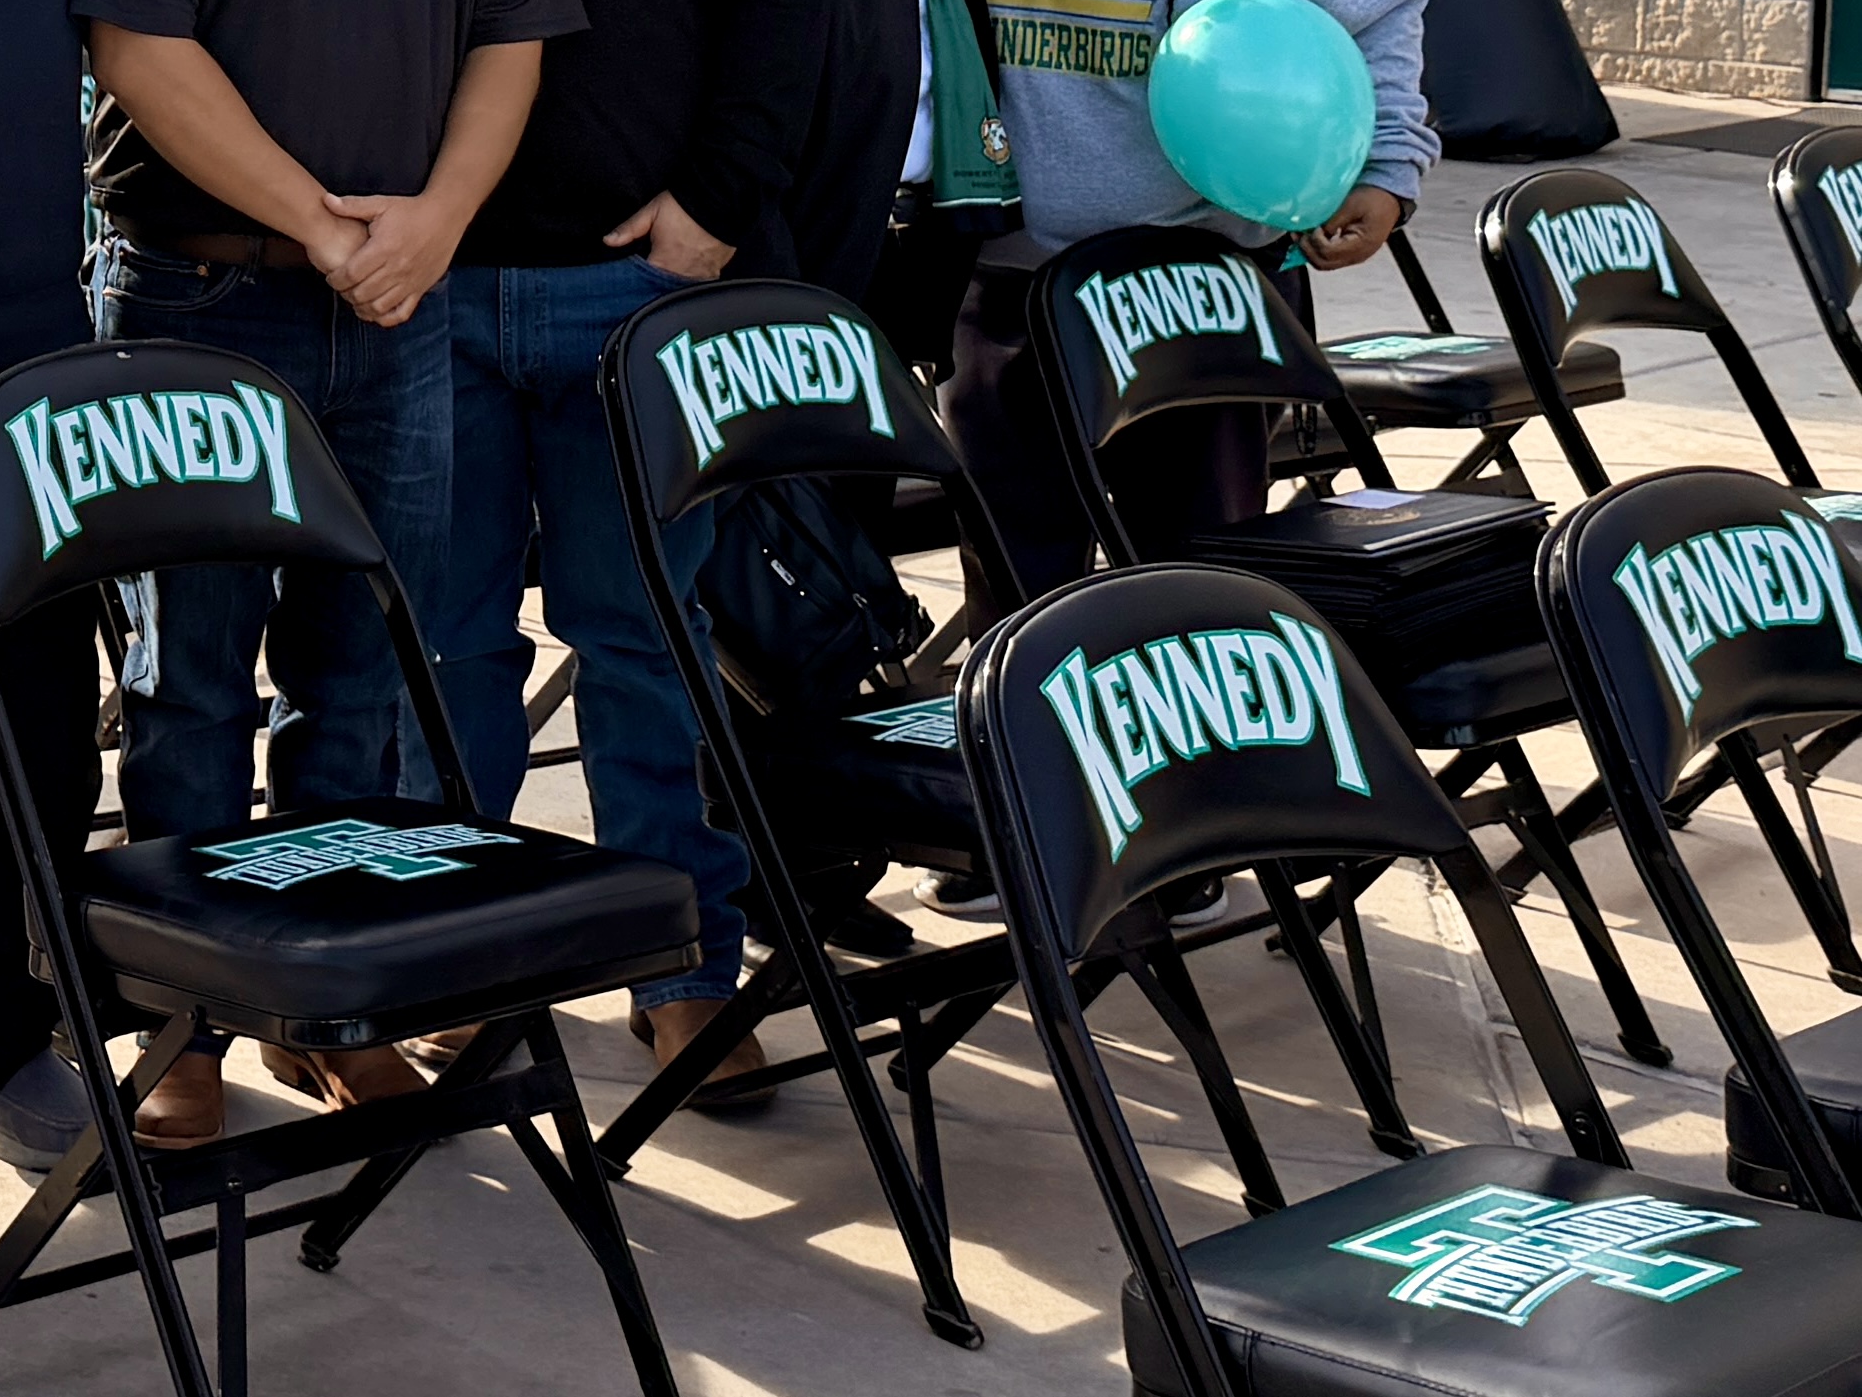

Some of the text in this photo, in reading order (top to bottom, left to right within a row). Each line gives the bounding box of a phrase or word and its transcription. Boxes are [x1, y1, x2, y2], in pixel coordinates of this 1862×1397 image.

[991, 16, 1152, 78] NDERBIRDS
[1074, 253, 1285, 399] KENNEDY
[1526, 195, 1680, 323] KENNEDY
[655, 313, 895, 472] KENNEDY
[5, 380, 301, 561] KENNEDY
[1612, 508, 1862, 728] KENNEDY
[1039, 610, 1372, 866] KENNEDY
[212, 826, 483, 890] THUNDERBIRDS
[1410, 1200, 1706, 1328] THUNDERBIRDS
